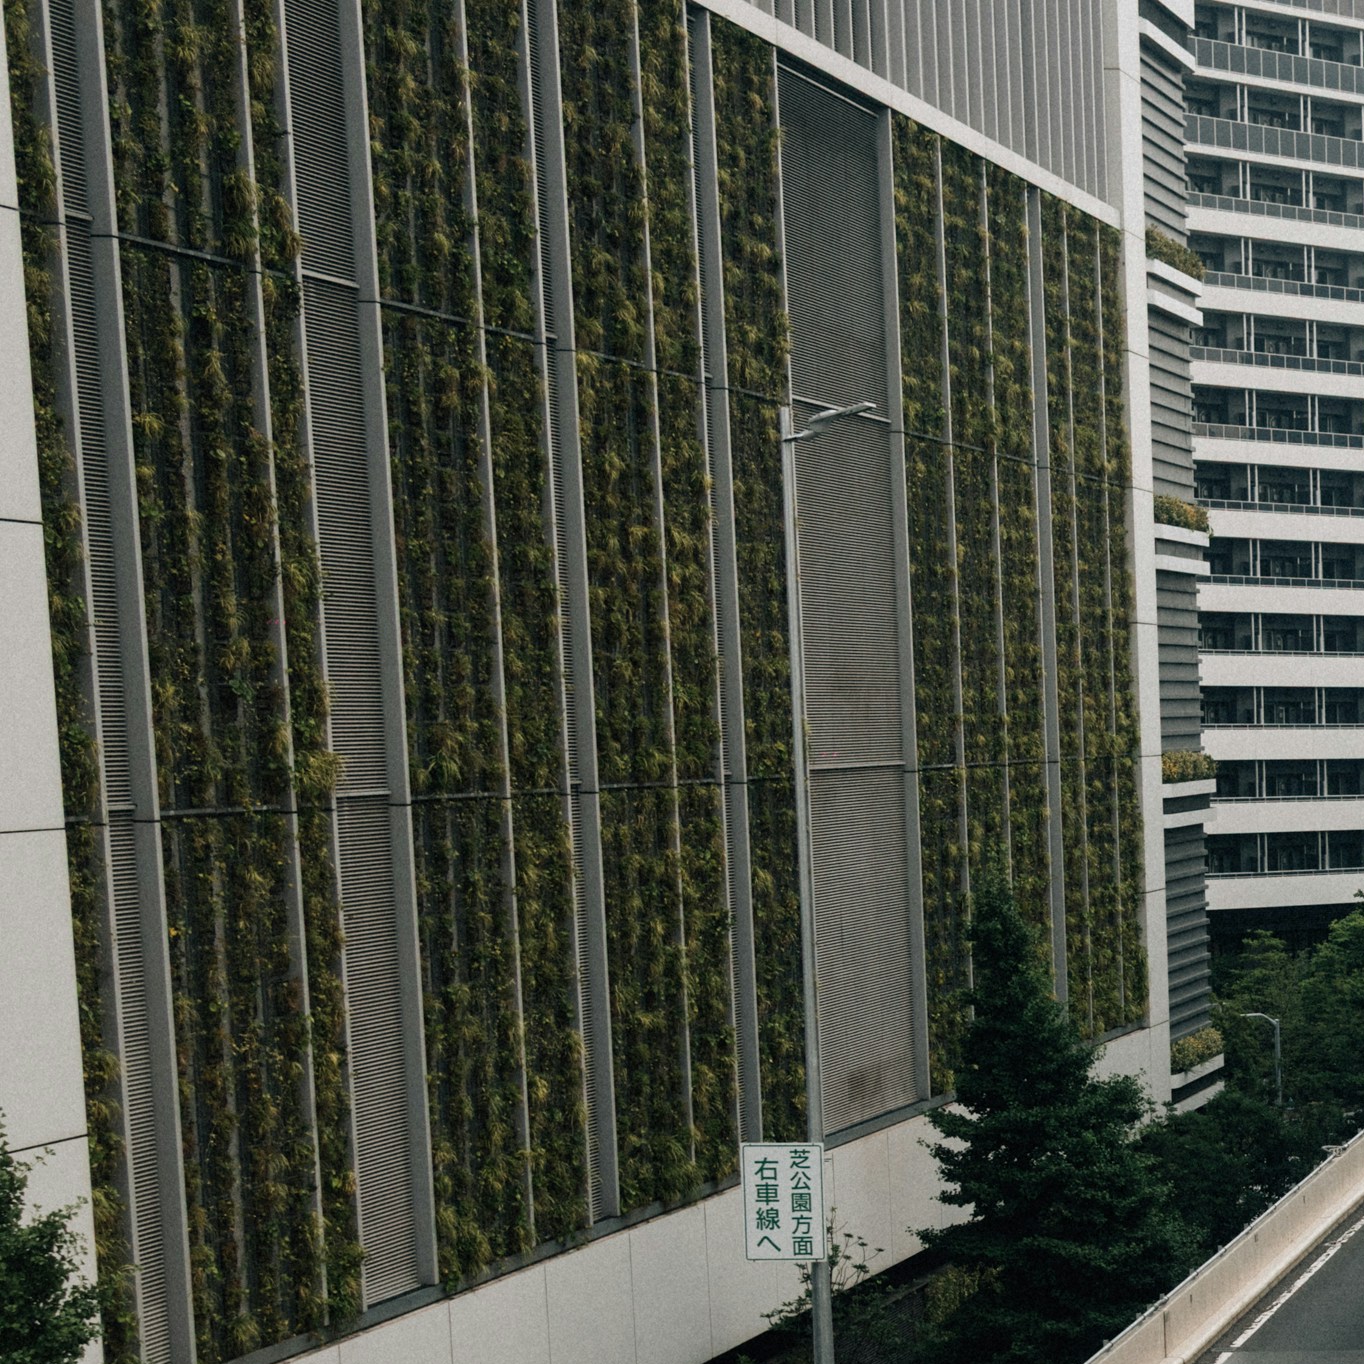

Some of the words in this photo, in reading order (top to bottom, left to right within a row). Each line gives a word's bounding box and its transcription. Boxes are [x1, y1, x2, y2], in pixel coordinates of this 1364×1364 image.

[754, 1157, 781, 1252] 右車線へ
[789, 1149, 813, 1256] 芝公園方面
